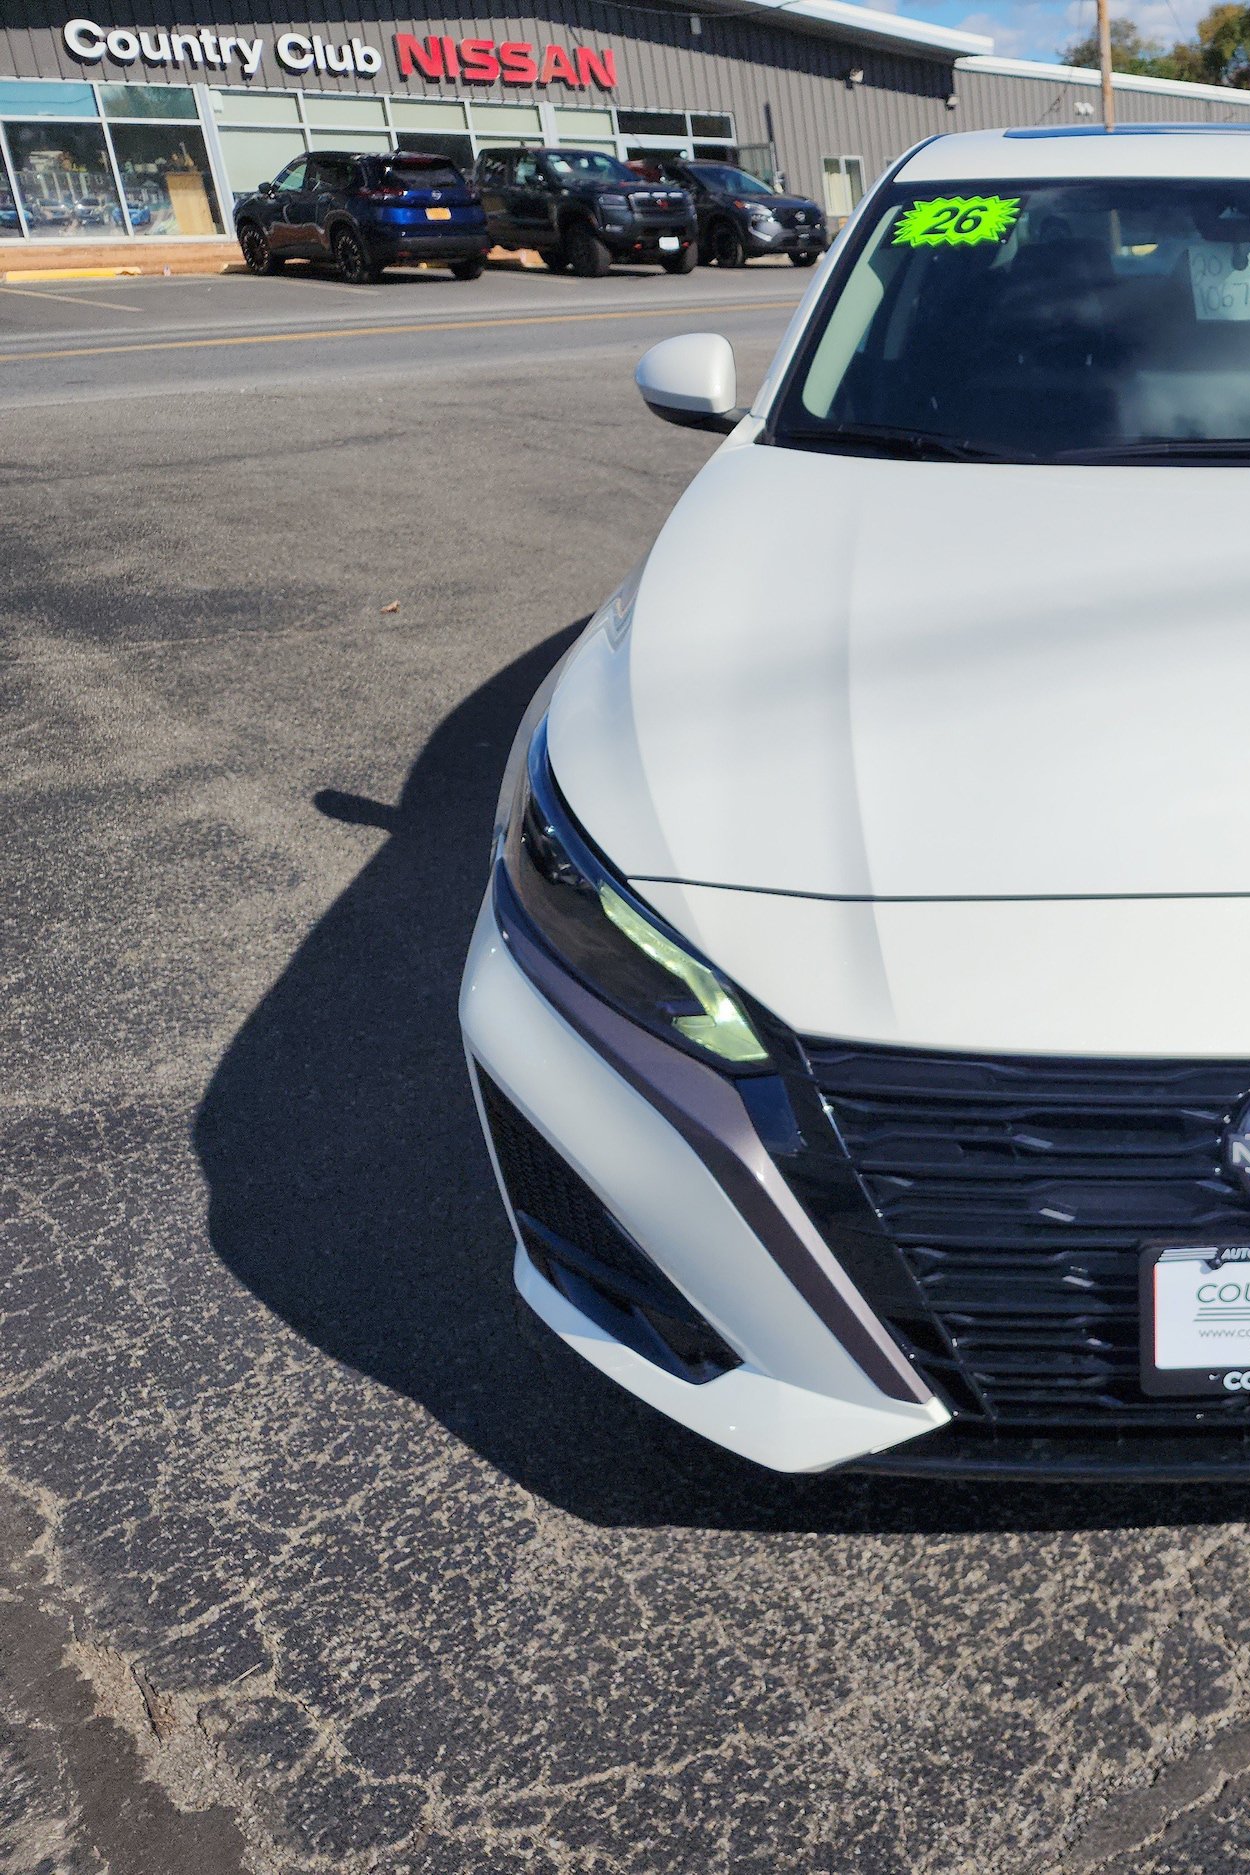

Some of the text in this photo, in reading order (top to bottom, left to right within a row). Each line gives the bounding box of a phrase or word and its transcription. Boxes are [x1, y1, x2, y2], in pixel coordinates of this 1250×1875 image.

[63, 18, 617, 88] Country Club NISSAN
[920, 206, 988, 235] 26
